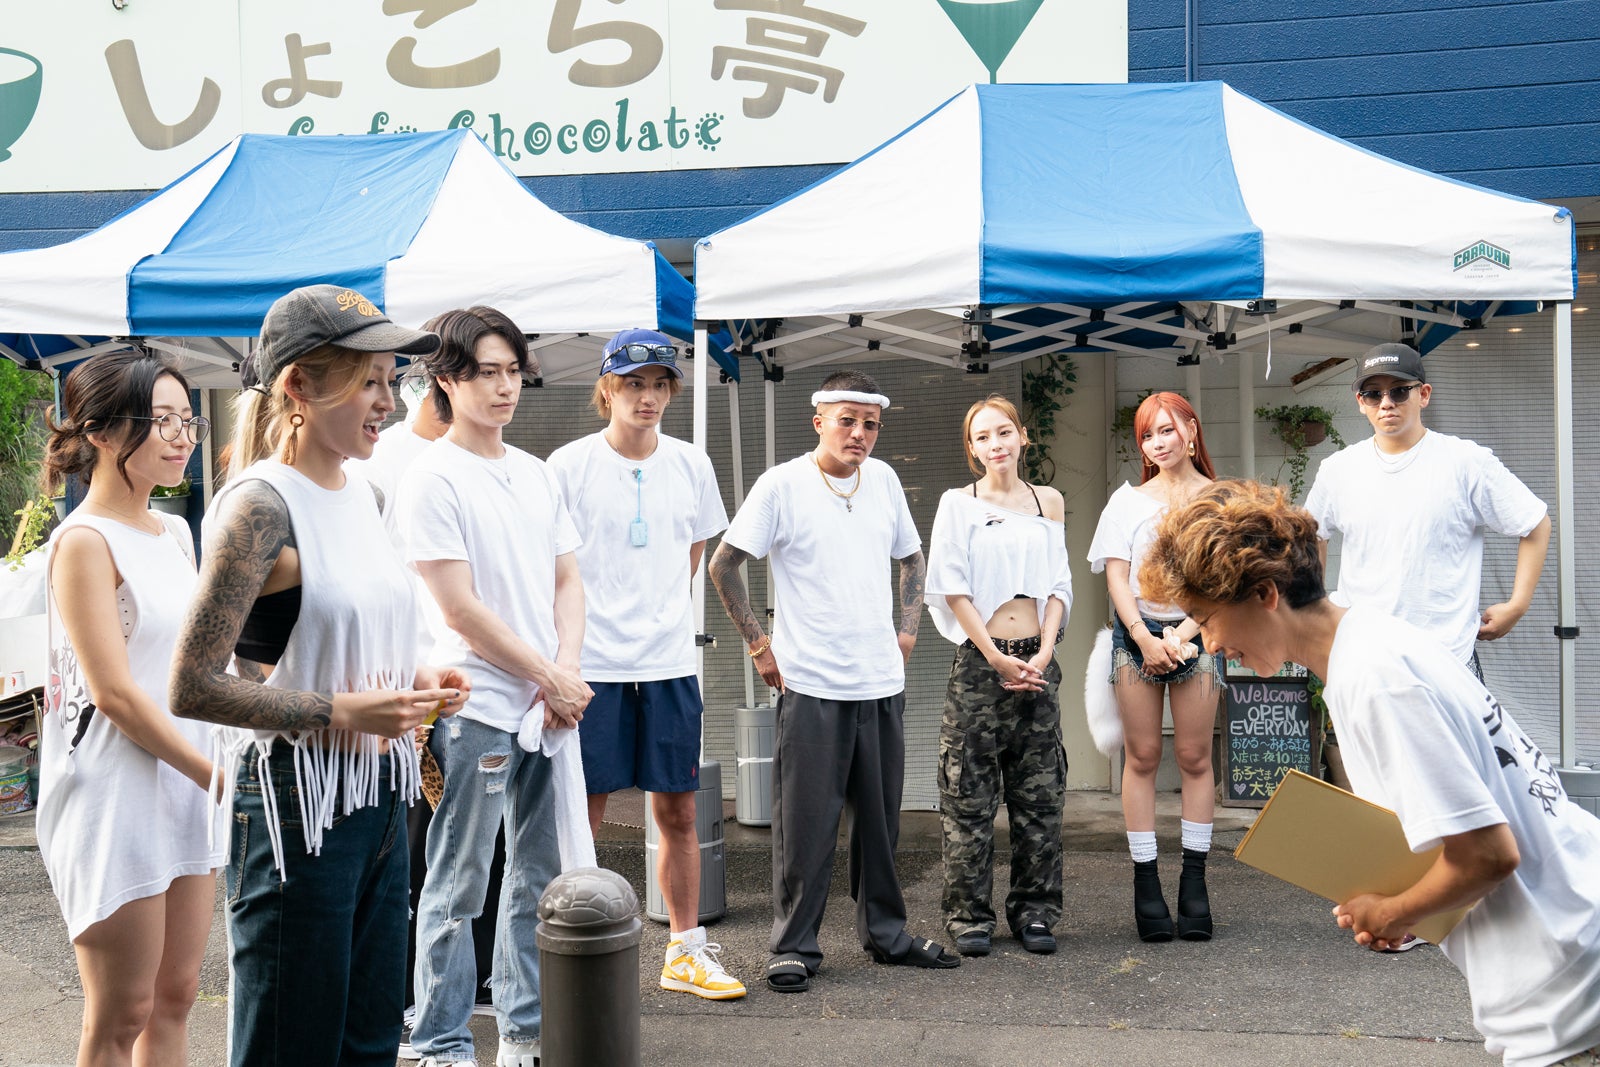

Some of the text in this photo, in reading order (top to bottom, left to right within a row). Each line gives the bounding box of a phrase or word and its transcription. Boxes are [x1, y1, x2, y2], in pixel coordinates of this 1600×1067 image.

[1454, 243, 1510, 268] CARAVAN
[1364, 356, 1399, 368] Supreme
[1230, 683, 1307, 704] Welcome
[1247, 704, 1297, 721] OPEN
[1230, 719, 1310, 736] EVERYDAY
